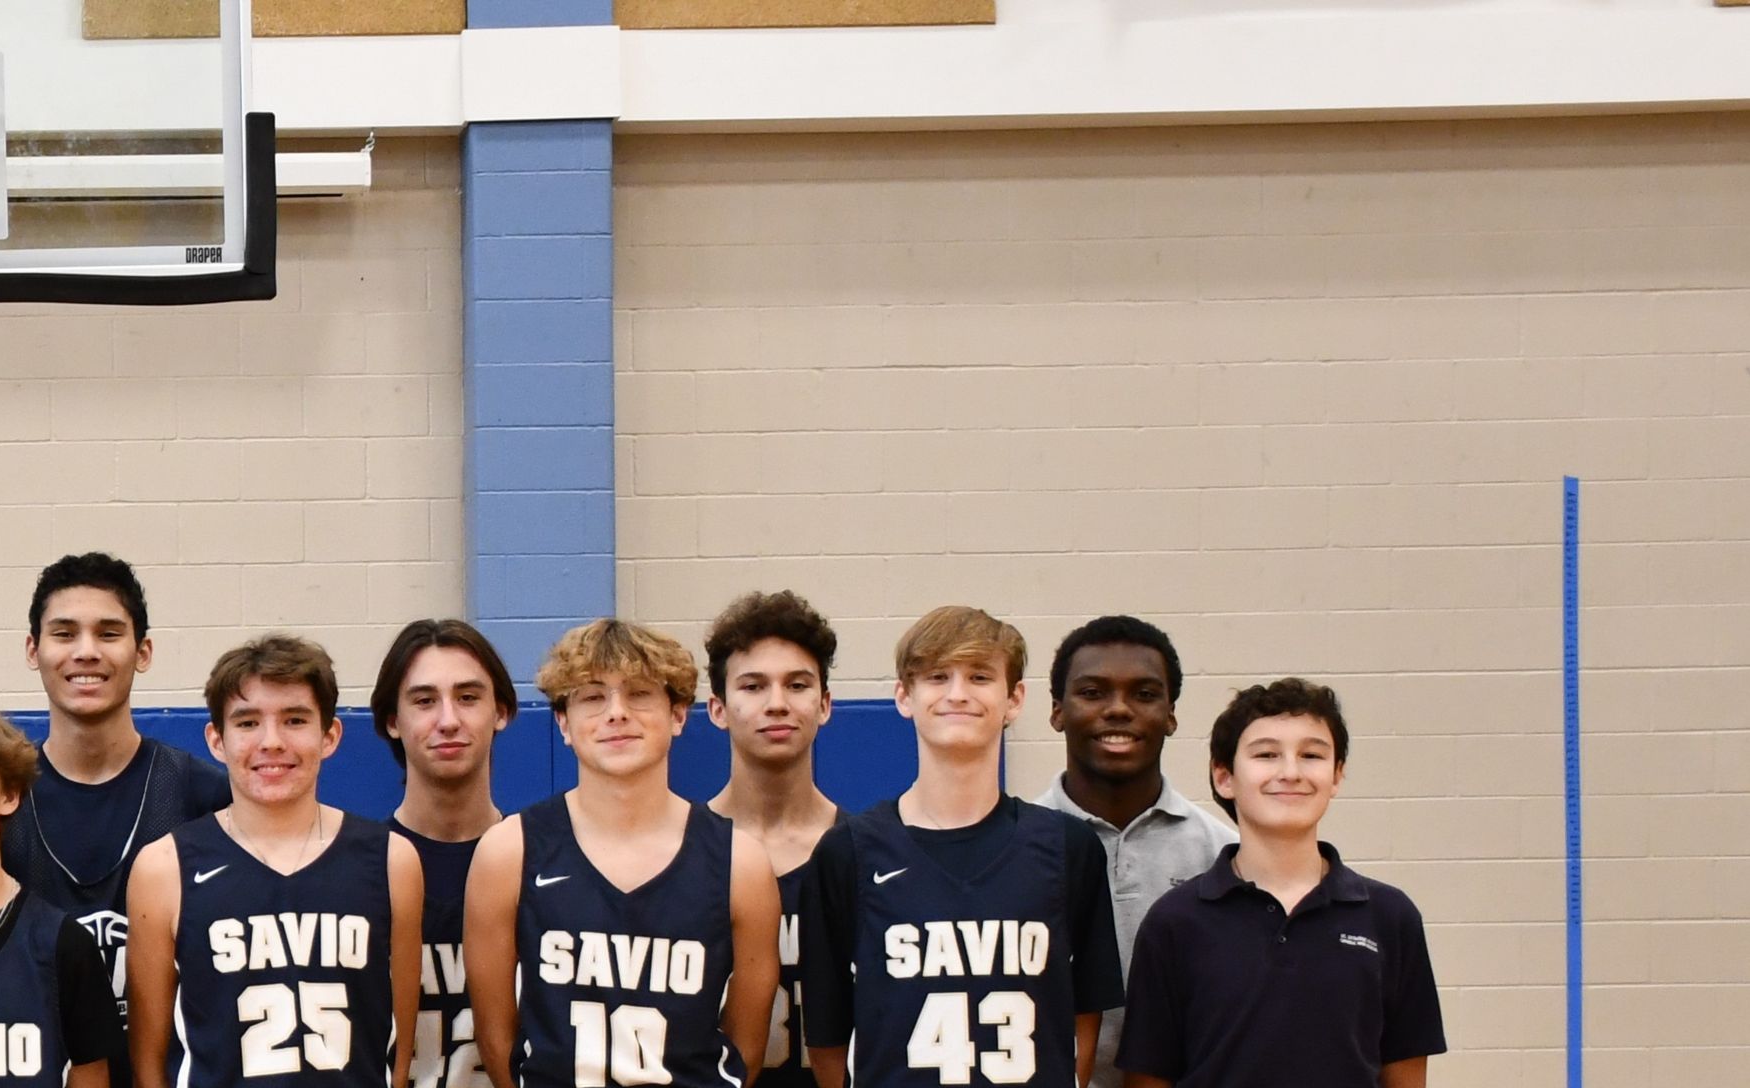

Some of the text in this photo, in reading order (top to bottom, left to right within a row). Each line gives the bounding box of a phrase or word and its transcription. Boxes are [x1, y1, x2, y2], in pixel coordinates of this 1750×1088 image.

[208, 911, 370, 974] SAVIO
[539, 930, 706, 995] SAVIO
[884, 919, 1050, 979] SAVIO
[236, 980, 352, 1078] 25
[569, 1000, 673, 1088] 10
[906, 991, 1036, 1085] 43
